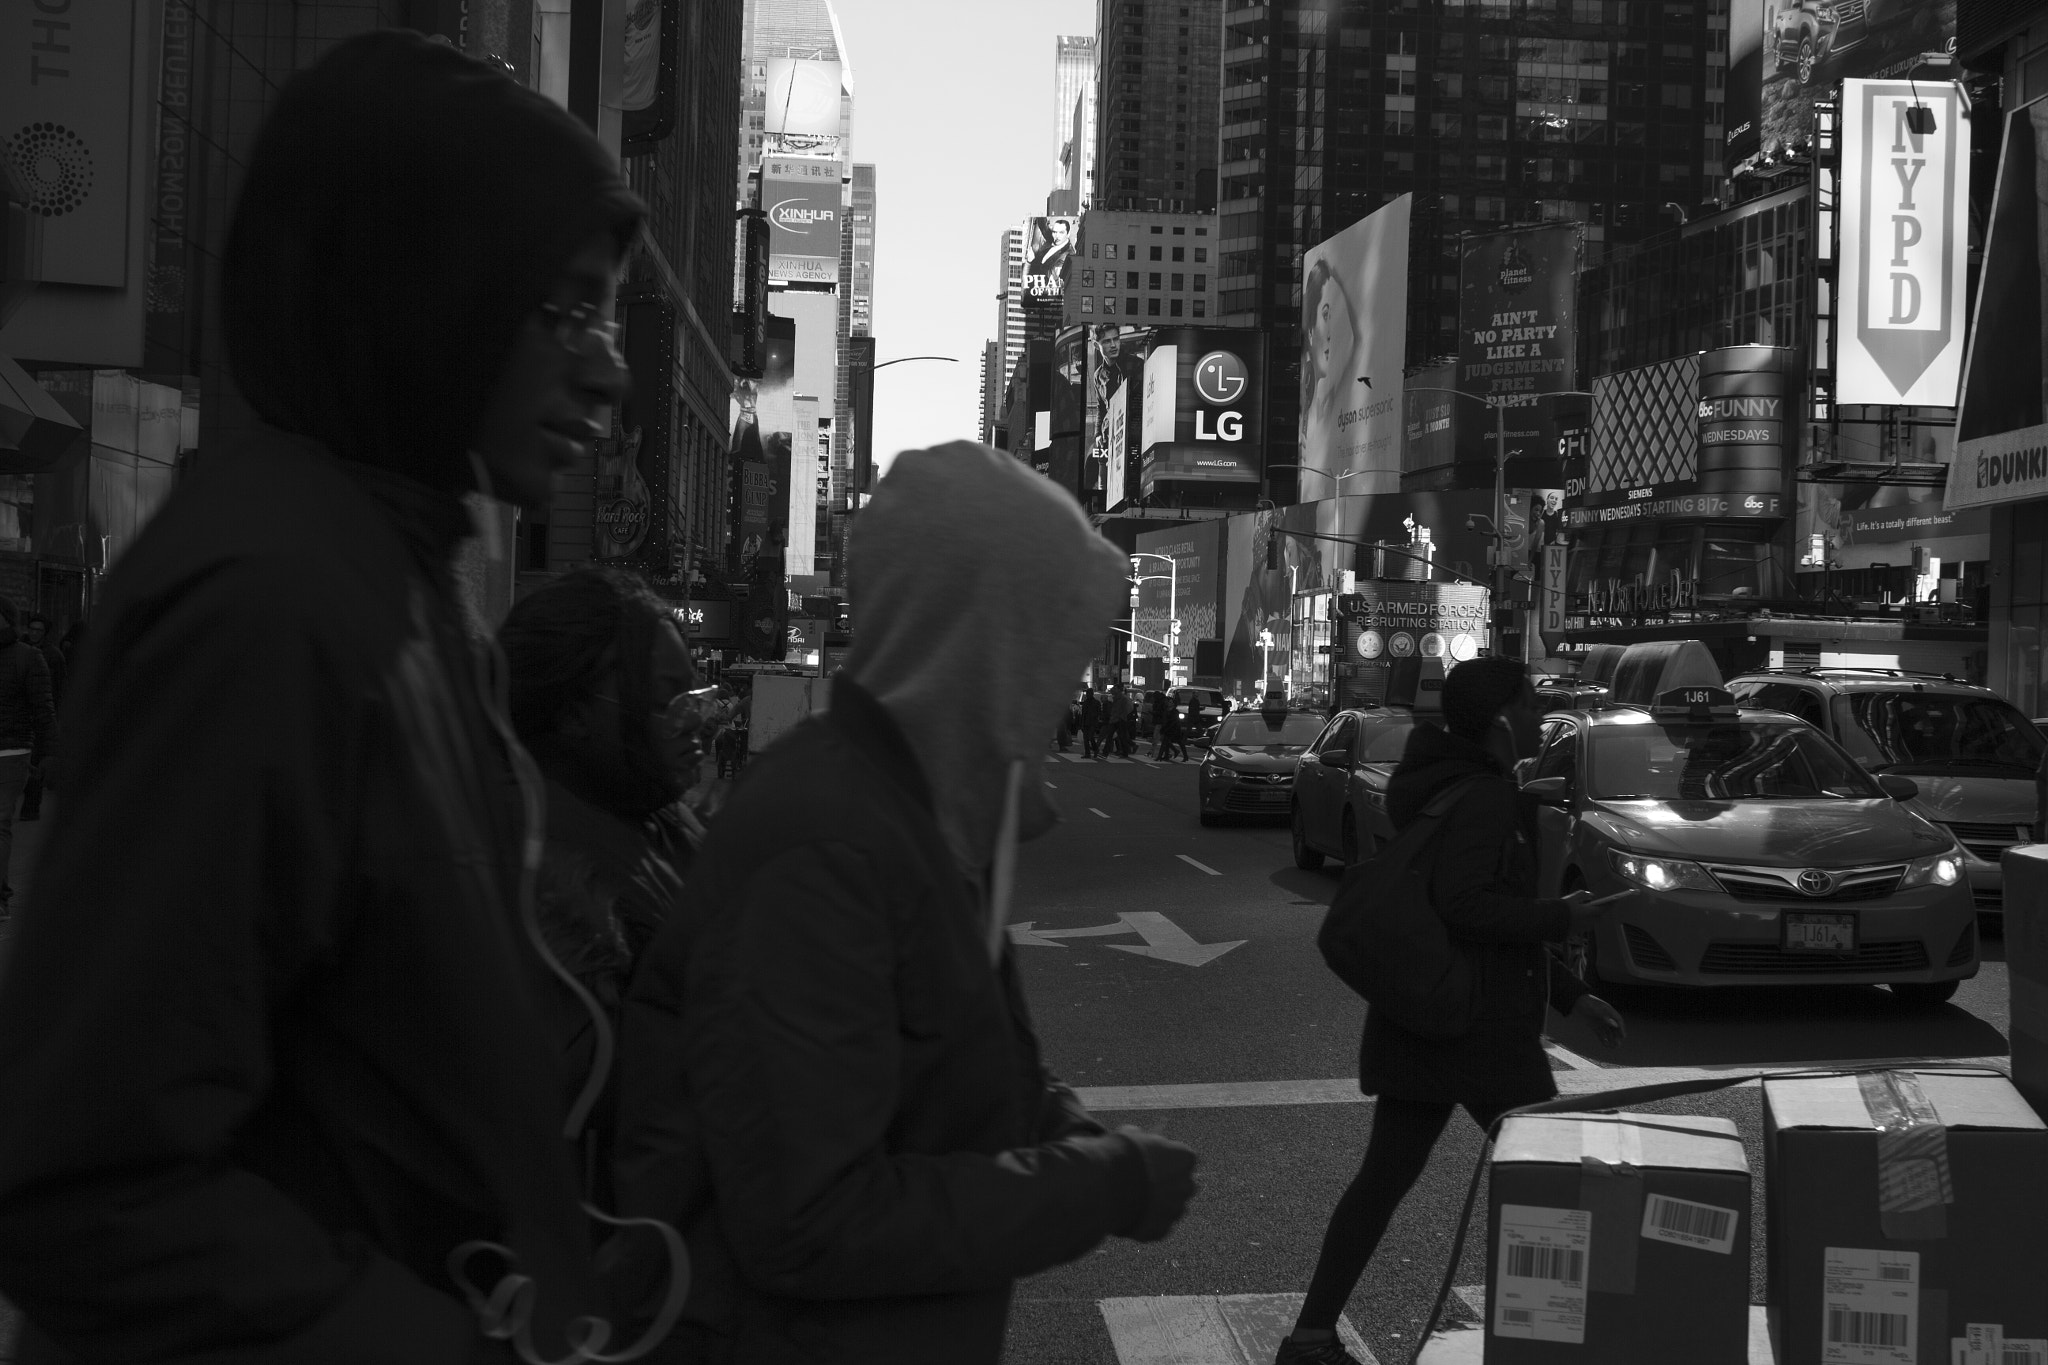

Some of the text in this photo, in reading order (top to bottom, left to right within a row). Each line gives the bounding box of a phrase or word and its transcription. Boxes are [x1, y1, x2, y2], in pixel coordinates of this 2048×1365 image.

[778, 207, 835, 221] XINHUA
[1890, 101, 1929, 326] NYPD
[768, 268, 833, 281] NEWS AGENCY
[778, 260, 823, 272] XINHUA
[1500, 268, 1527, 280] planet
[1503, 276, 1532, 285] fitness
[1030, 287, 1046, 297] OF
[1491, 310, 1538, 327] AIN'T
[1474, 325, 1557, 345] NO PARTY
[1486, 343, 1542, 360] LIKE A
[1465, 358, 1565, 382] JUDGEMENT
[1491, 377, 1535, 392] FREE
[1714, 398, 1779, 419] FUNNY
[1195, 409, 1243, 442] LG
[1338, 408, 1357, 433] dyson
[1702, 429, 1770, 444] WEDNESDAYS
[1990, 445, 2047, 487] DUNKI
[744, 468, 769, 488] BUBBA
[1628, 487, 1653, 500] SIEMENS
[596, 506, 647, 527] Hard Rock
[1570, 509, 1599, 525] FUNNY
[1599, 502, 1642, 522] WEDNESDAYS
[1642, 498, 1694, 516] STARTING
[613, 527, 629, 535] CAFE
[1856, 522, 1870, 531] Life.
[1870, 521, 1880, 530] It's
[1885, 518, 1905, 530] totally
[1905, 516, 1932, 527] different
[1549, 549, 1562, 629] NYPD
[1374, 602, 1428, 616] ARMED
[1429, 603, 1485, 619] FORCES
[1356, 616, 1477, 632] RECRUITING STATION
[1684, 691, 1709, 703] 1J61
